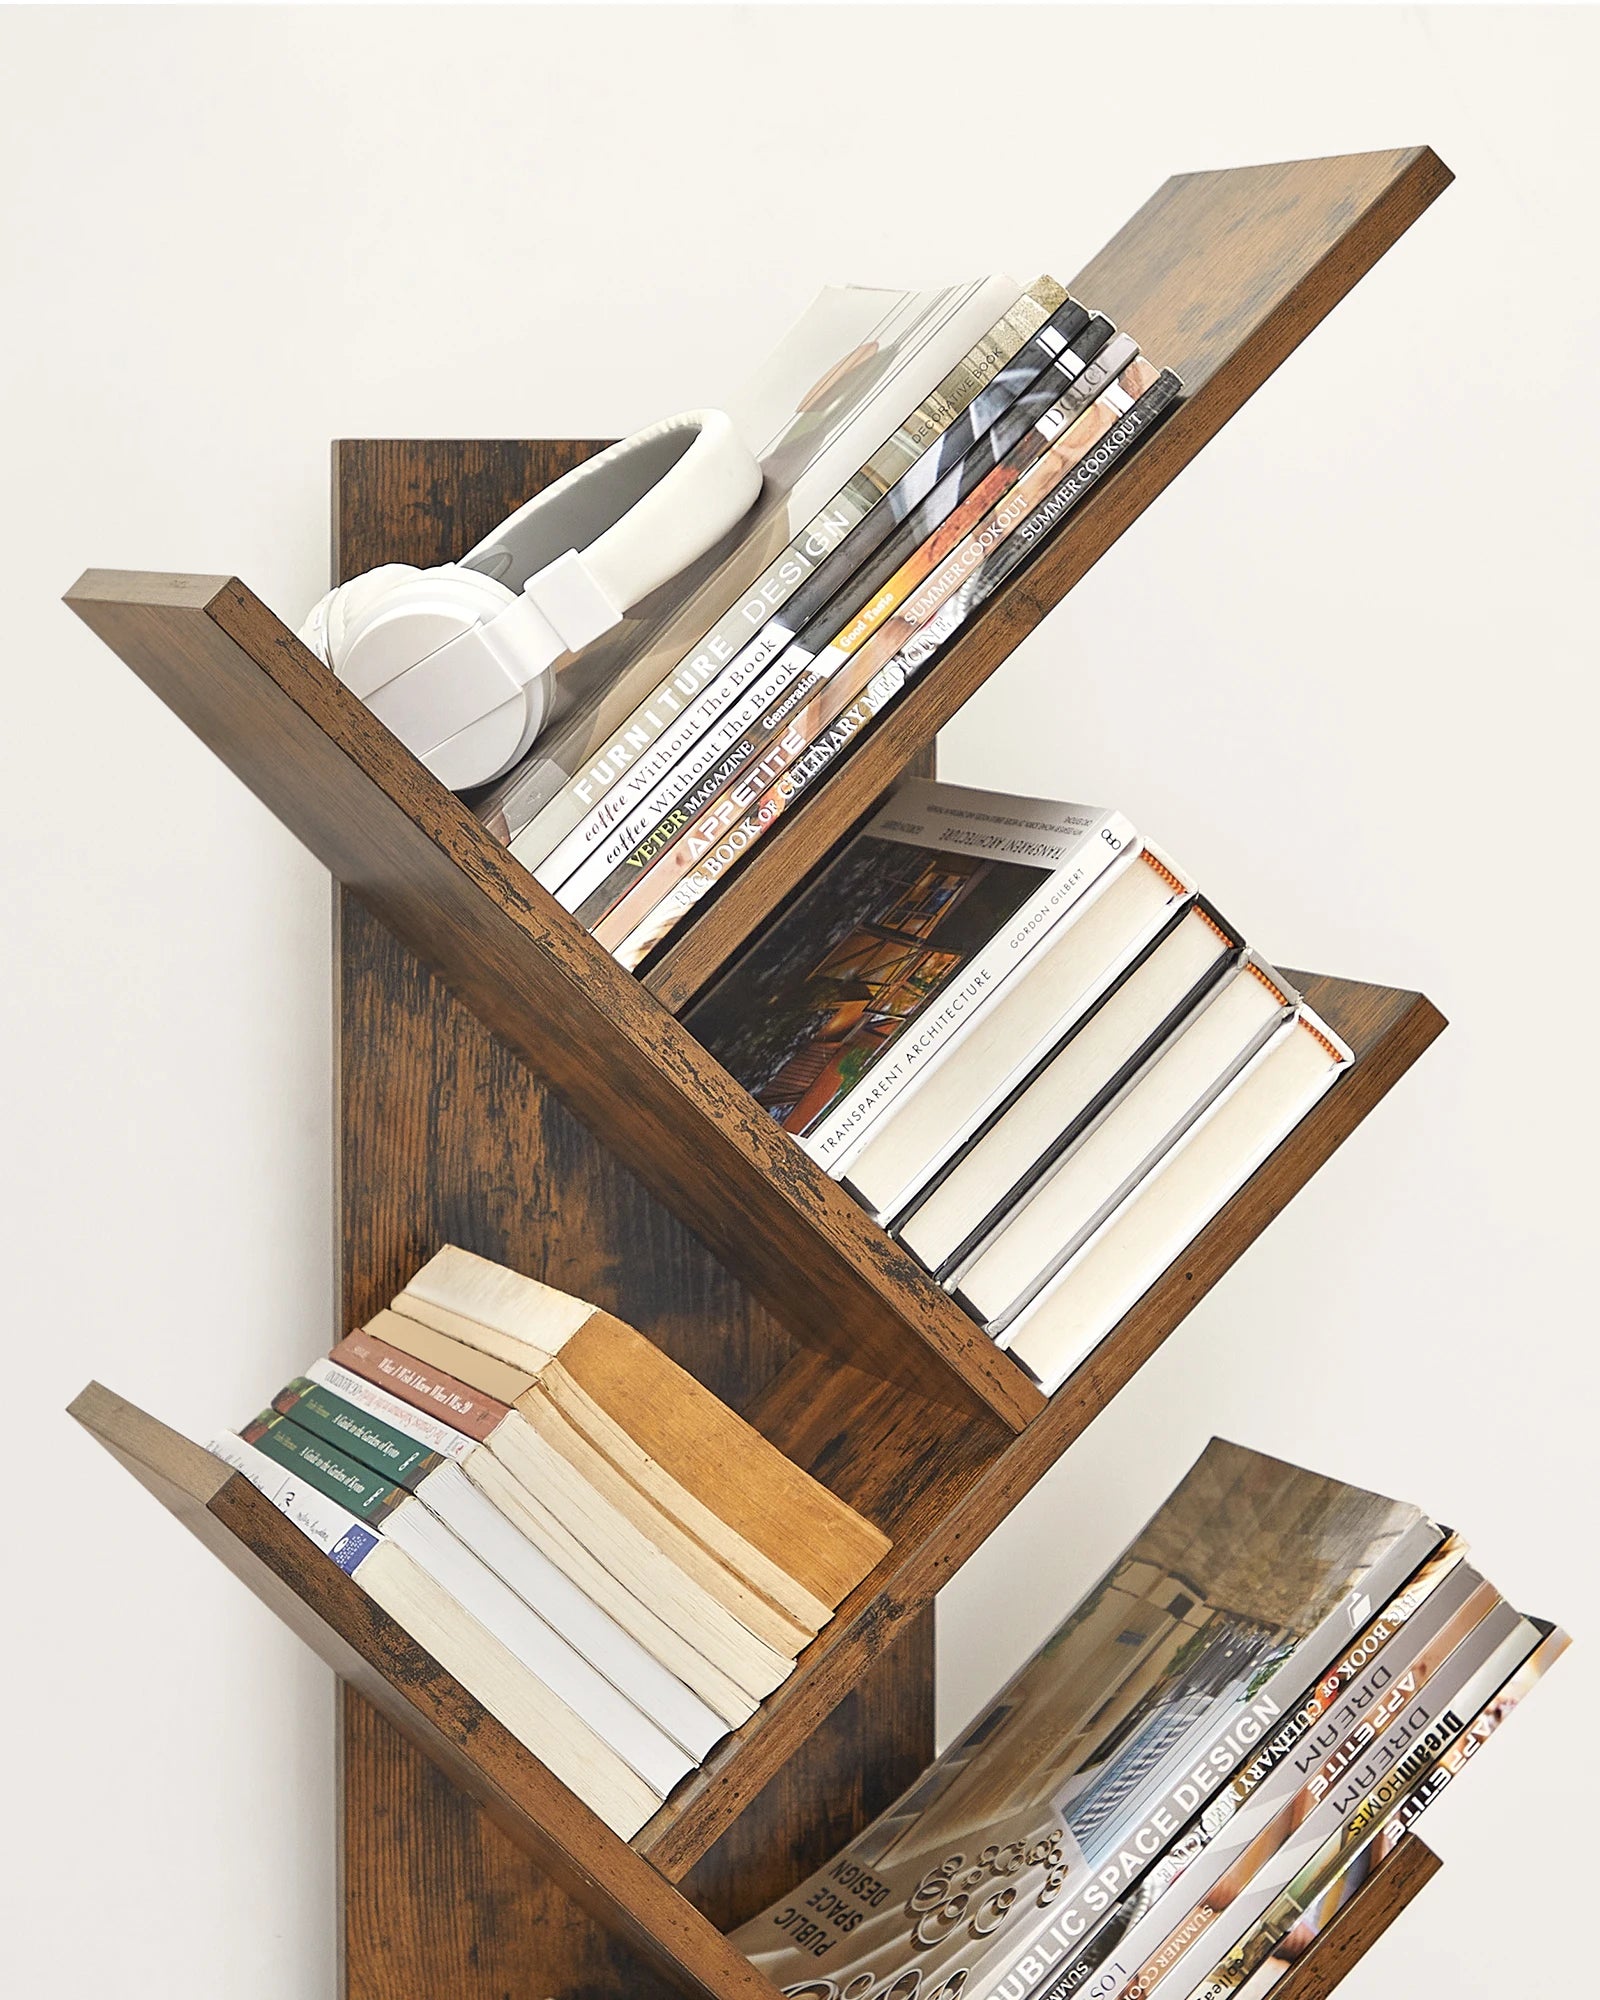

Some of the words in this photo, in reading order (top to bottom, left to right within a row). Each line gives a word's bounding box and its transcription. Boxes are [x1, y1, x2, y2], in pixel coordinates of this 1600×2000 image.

[910, 376, 974, 444] DECORATIVE
[970, 345, 1003, 379] BOOK
[1043, 358, 1110, 428] DOLCI
[1019, 476, 1082, 542] SUMMER
[1074, 409, 1144, 483] COOKOUT
[902, 561, 966, 628] SUMMER
[958, 492, 1030, 568] COOKOUT
[572, 632, 734, 806] FURNITURE
[740, 508, 851, 626] DESIGN
[838, 619, 867, 649] Good
[578, 790, 630, 844] coffee
[626, 716, 700, 795] Without
[696, 682, 732, 720] The
[726, 634, 778, 688] Book
[600, 812, 651, 866] coffee
[647, 738, 722, 818] Without
[717, 705, 753, 743] The
[748, 657, 798, 710] Book
[671, 868, 710, 909] BIG
[702, 815, 763, 879] BOOK
[772, 699, 869, 802] CULINARY
[860, 613, 952, 711] MEDICINE
[625, 805, 689, 873] VETER
[682, 737, 755, 815] MAGAZINE
[679, 724, 807, 861] APPETITE
[1000, 838, 1066, 860] TRANSPARENT
[819, 1062, 905, 1155] TRANSPARENT
[902, 967, 992, 1064] ARCHITECTURE
[1008, 904, 1050, 949] GORDON
[1049, 867, 1085, 905] GILBERT
[1334, 1621, 1391, 1681] BOOK
[1383, 1590, 1420, 1628] BIG
[1232, 1695, 1327, 1796] CULINARY
[1291, 1664, 1394, 1774] DREAM
[1302, 1670, 1425, 1801] APPETITE
[1330, 1705, 1432, 1815] DREAM
[1079, 1806, 1181, 1914] SPACE
[1170, 1693, 1283, 1813] DESIGN
[1378, 1716, 1498, 1845] APPETITE
[828, 1859, 892, 1908] DESIGN
[1153, 1786, 1244, 1883] MEDICINE
[773, 1908, 838, 1957] PUBLIC
[806, 1887, 864, 1933] SPACE
[1154, 1903, 1215, 1968] SUMMER
[1090, 1963, 1127, 2000] LOS
[1203, 1958, 1244, 2000] collea
